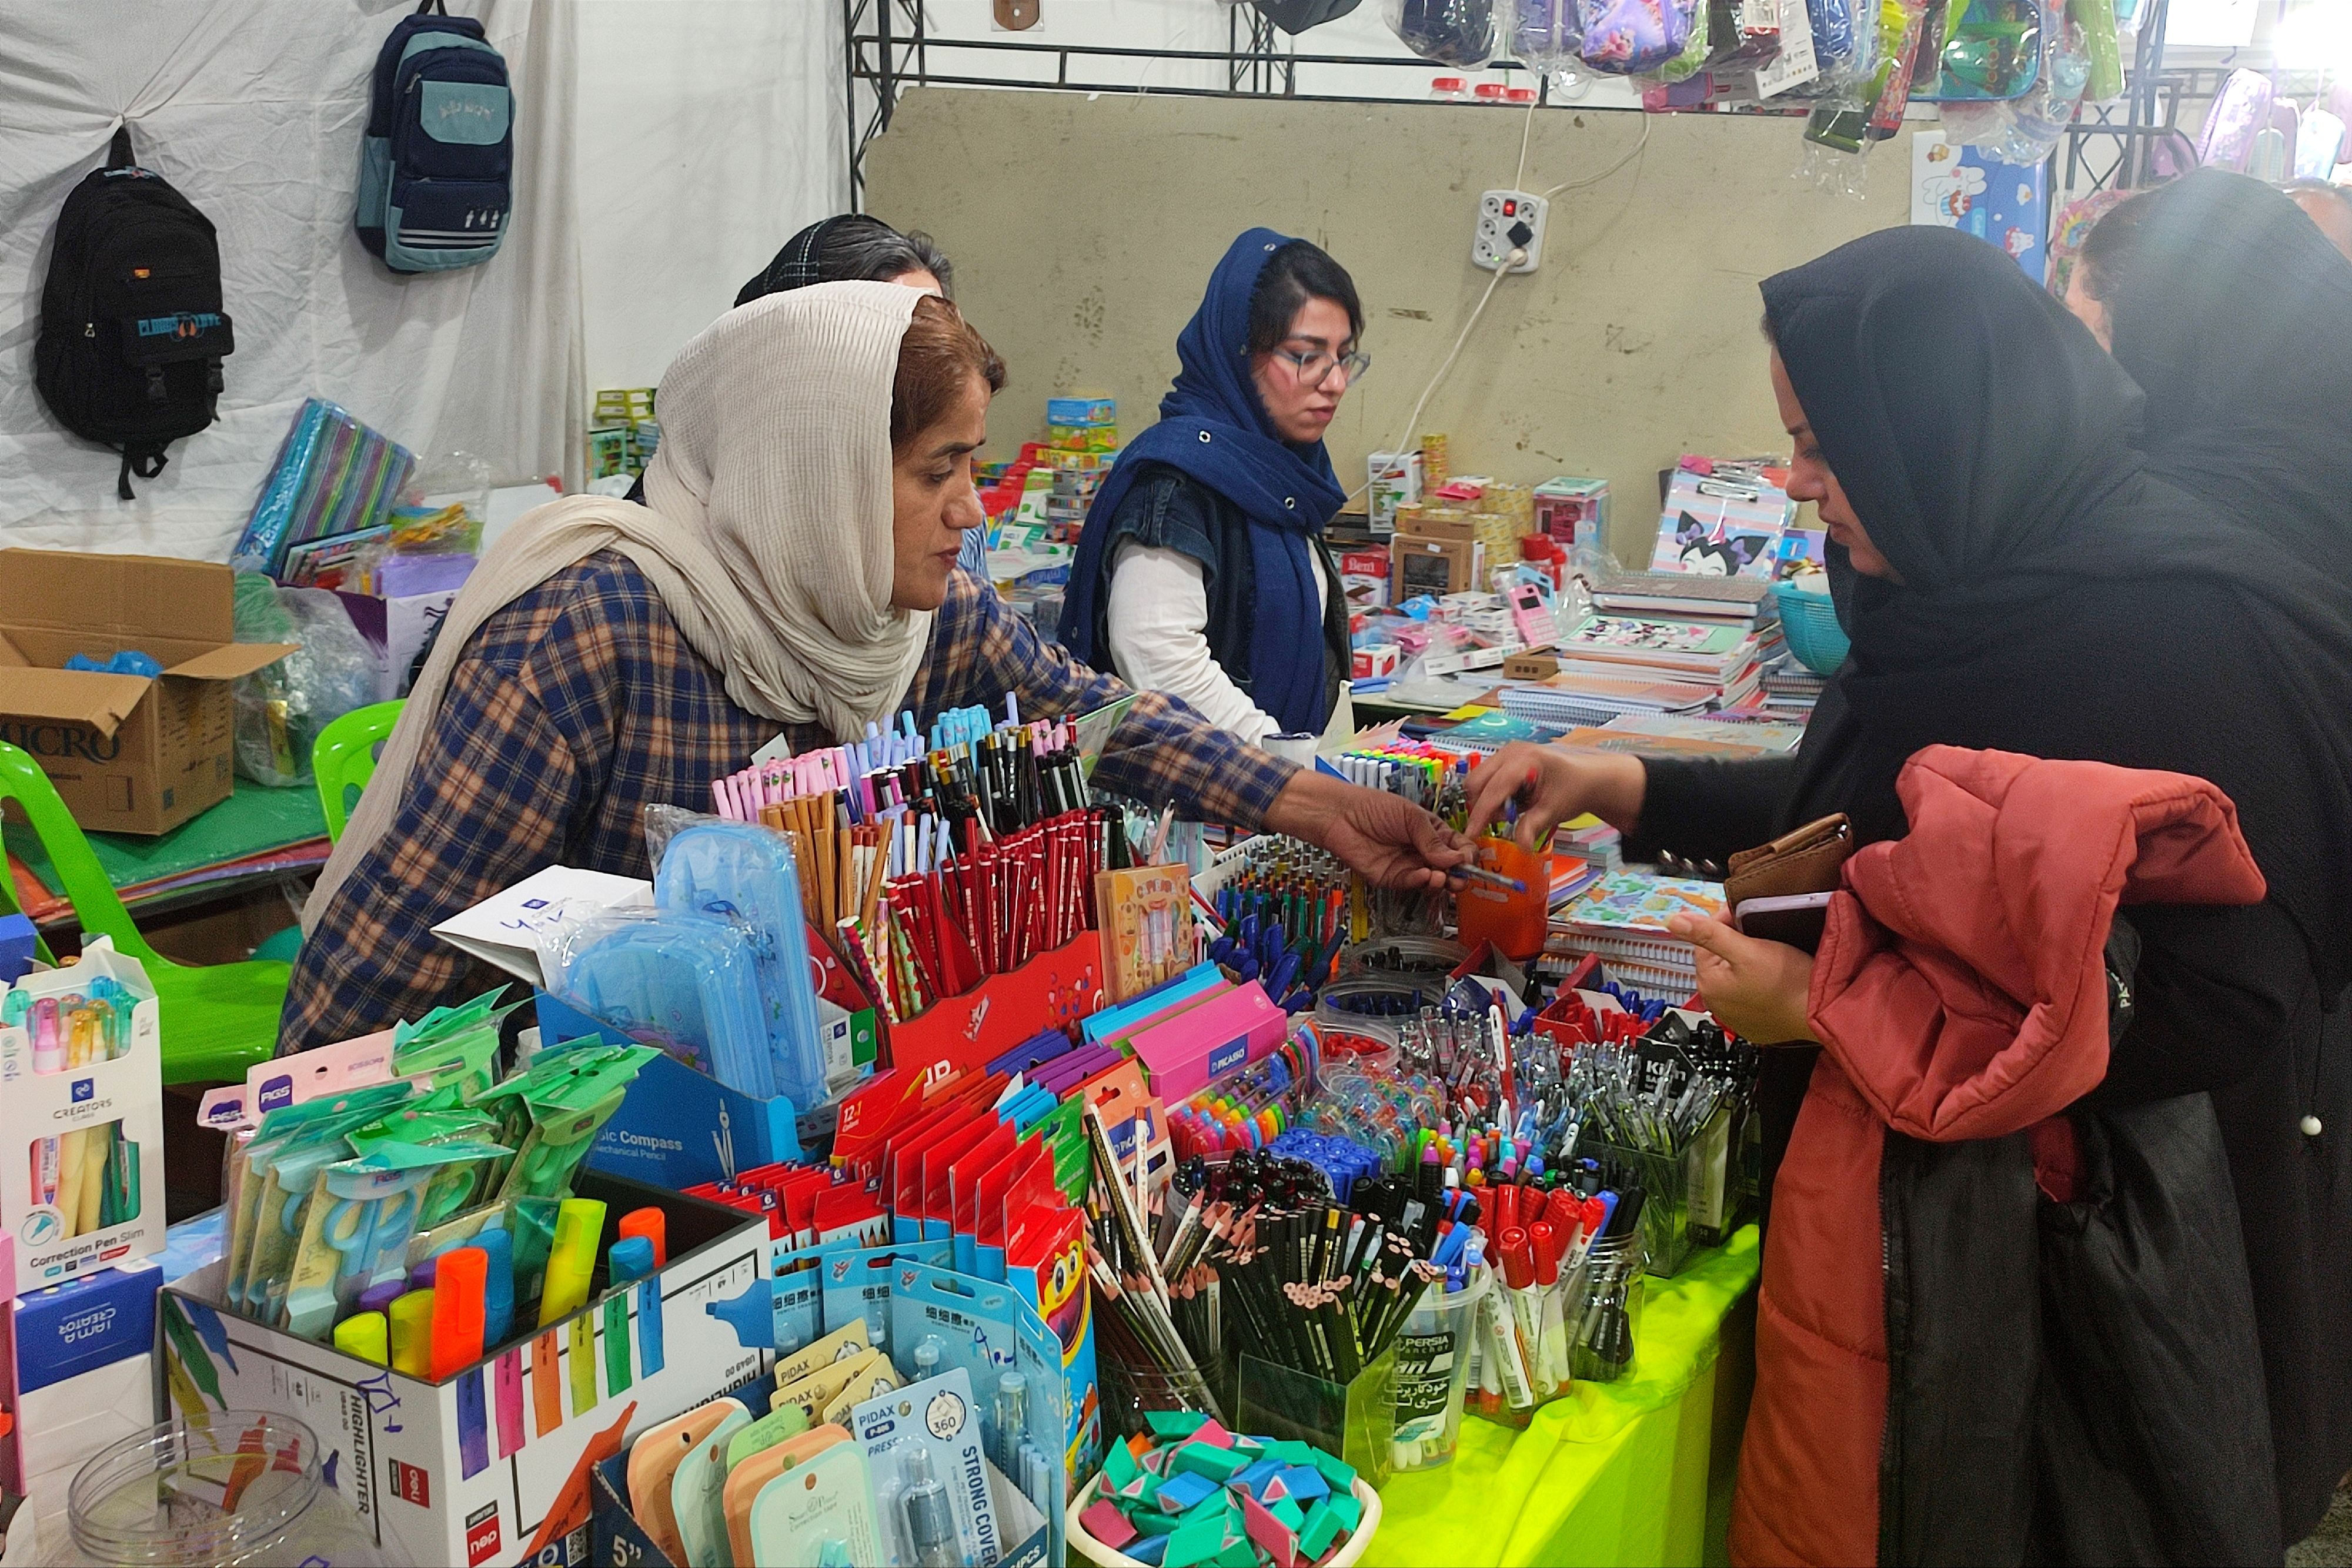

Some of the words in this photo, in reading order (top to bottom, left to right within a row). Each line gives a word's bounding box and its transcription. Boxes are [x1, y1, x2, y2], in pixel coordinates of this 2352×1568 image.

[0, 721, 121, 764] ICRO
[1217, 1047, 1245, 1070] PICASSO
[1646, 1059, 1686, 1082] Kin
[53, 1098, 112, 1119] CREATORS
[620, 1130, 683, 1151] Compass
[640, 1149, 666, 1161] Pencil
[834, 1169, 841, 1179] 6
[869, 1179, 877, 1188] 6
[741, 1186, 749, 1196] 6
[764, 1194, 772, 1204] 6
[30, 1245, 92, 1268] Correction
[95, 1236, 117, 1251] Pen
[119, 1228, 145, 1243] Slim
[58, 1308, 116, 1335] CREATOR
[1405, 1335, 1449, 1348] PERSIA
[780, 1359, 810, 1383] PIDAX
[858, 1404, 896, 1427] PIDAX
[933, 1416, 957, 1434] 360
[350, 1394, 370, 1514] HIGHLIGHTER
[962, 1445, 988, 1512] STRONG
[975, 1513, 998, 1568] COVER
